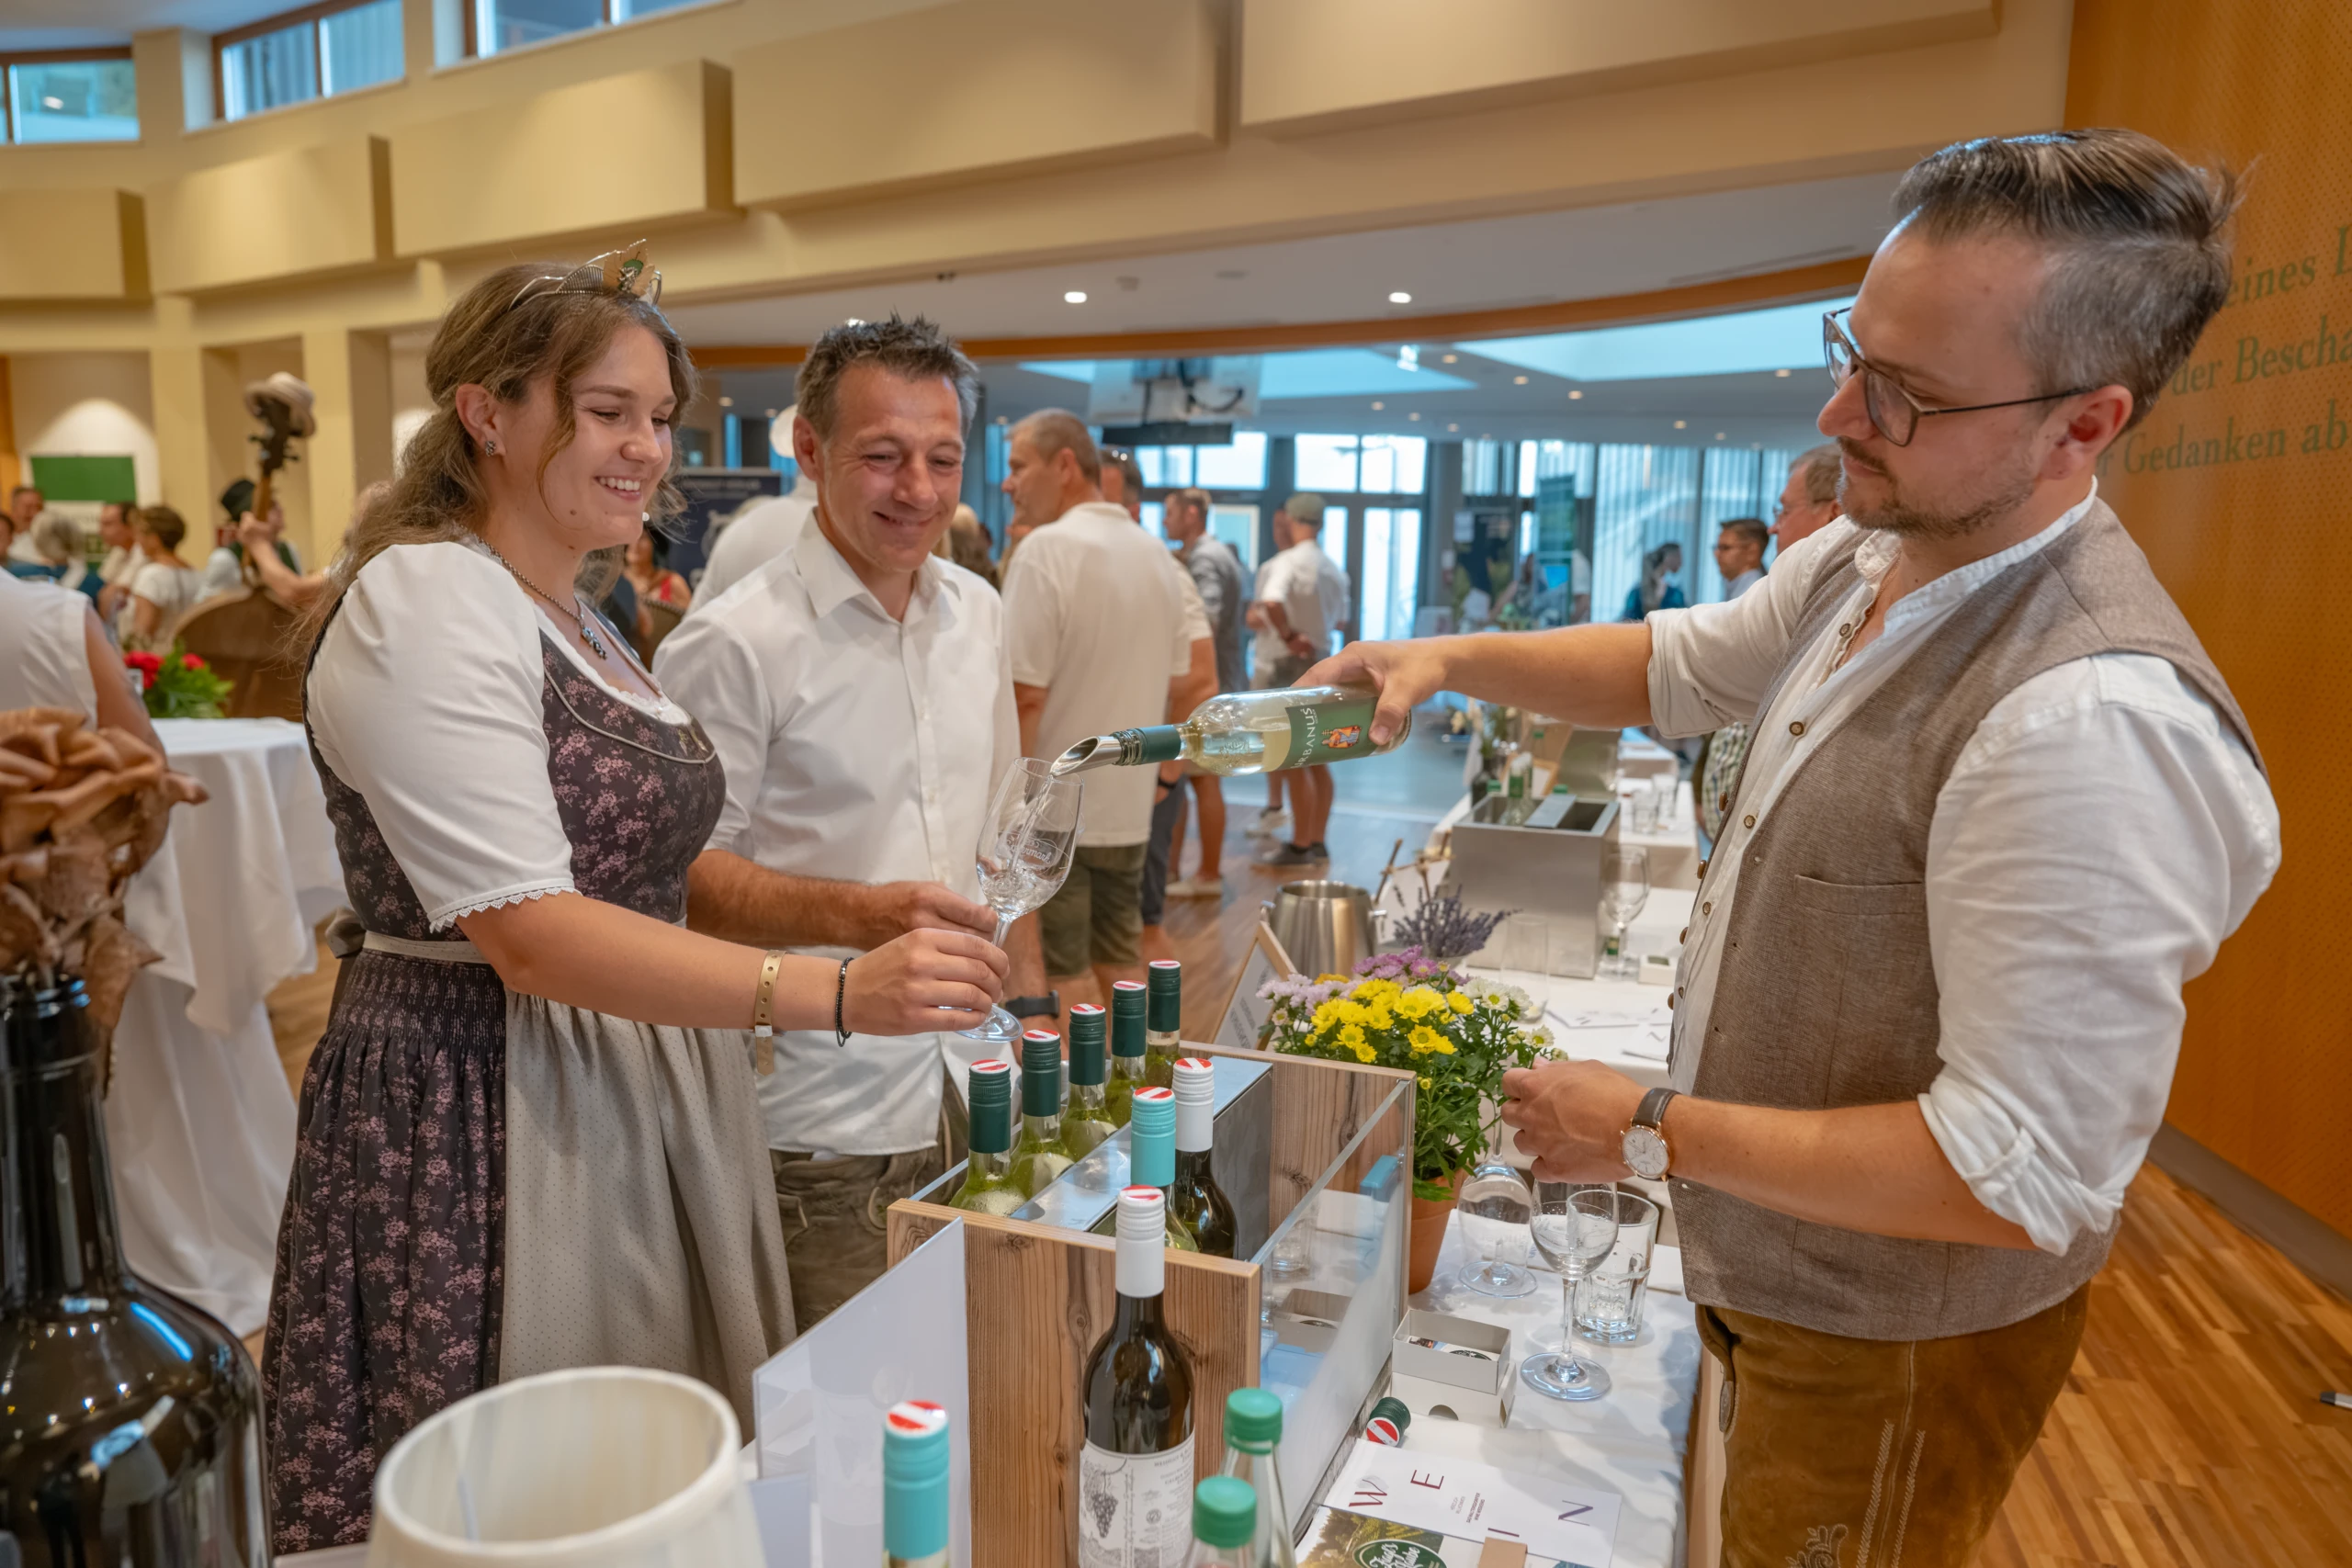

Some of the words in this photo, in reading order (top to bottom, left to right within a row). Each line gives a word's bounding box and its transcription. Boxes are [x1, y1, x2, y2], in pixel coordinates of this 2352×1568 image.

[2172, 359, 2222, 395] der
[2123, 416, 2286, 475] Gedanken
[2301, 398, 2347, 454] ab
